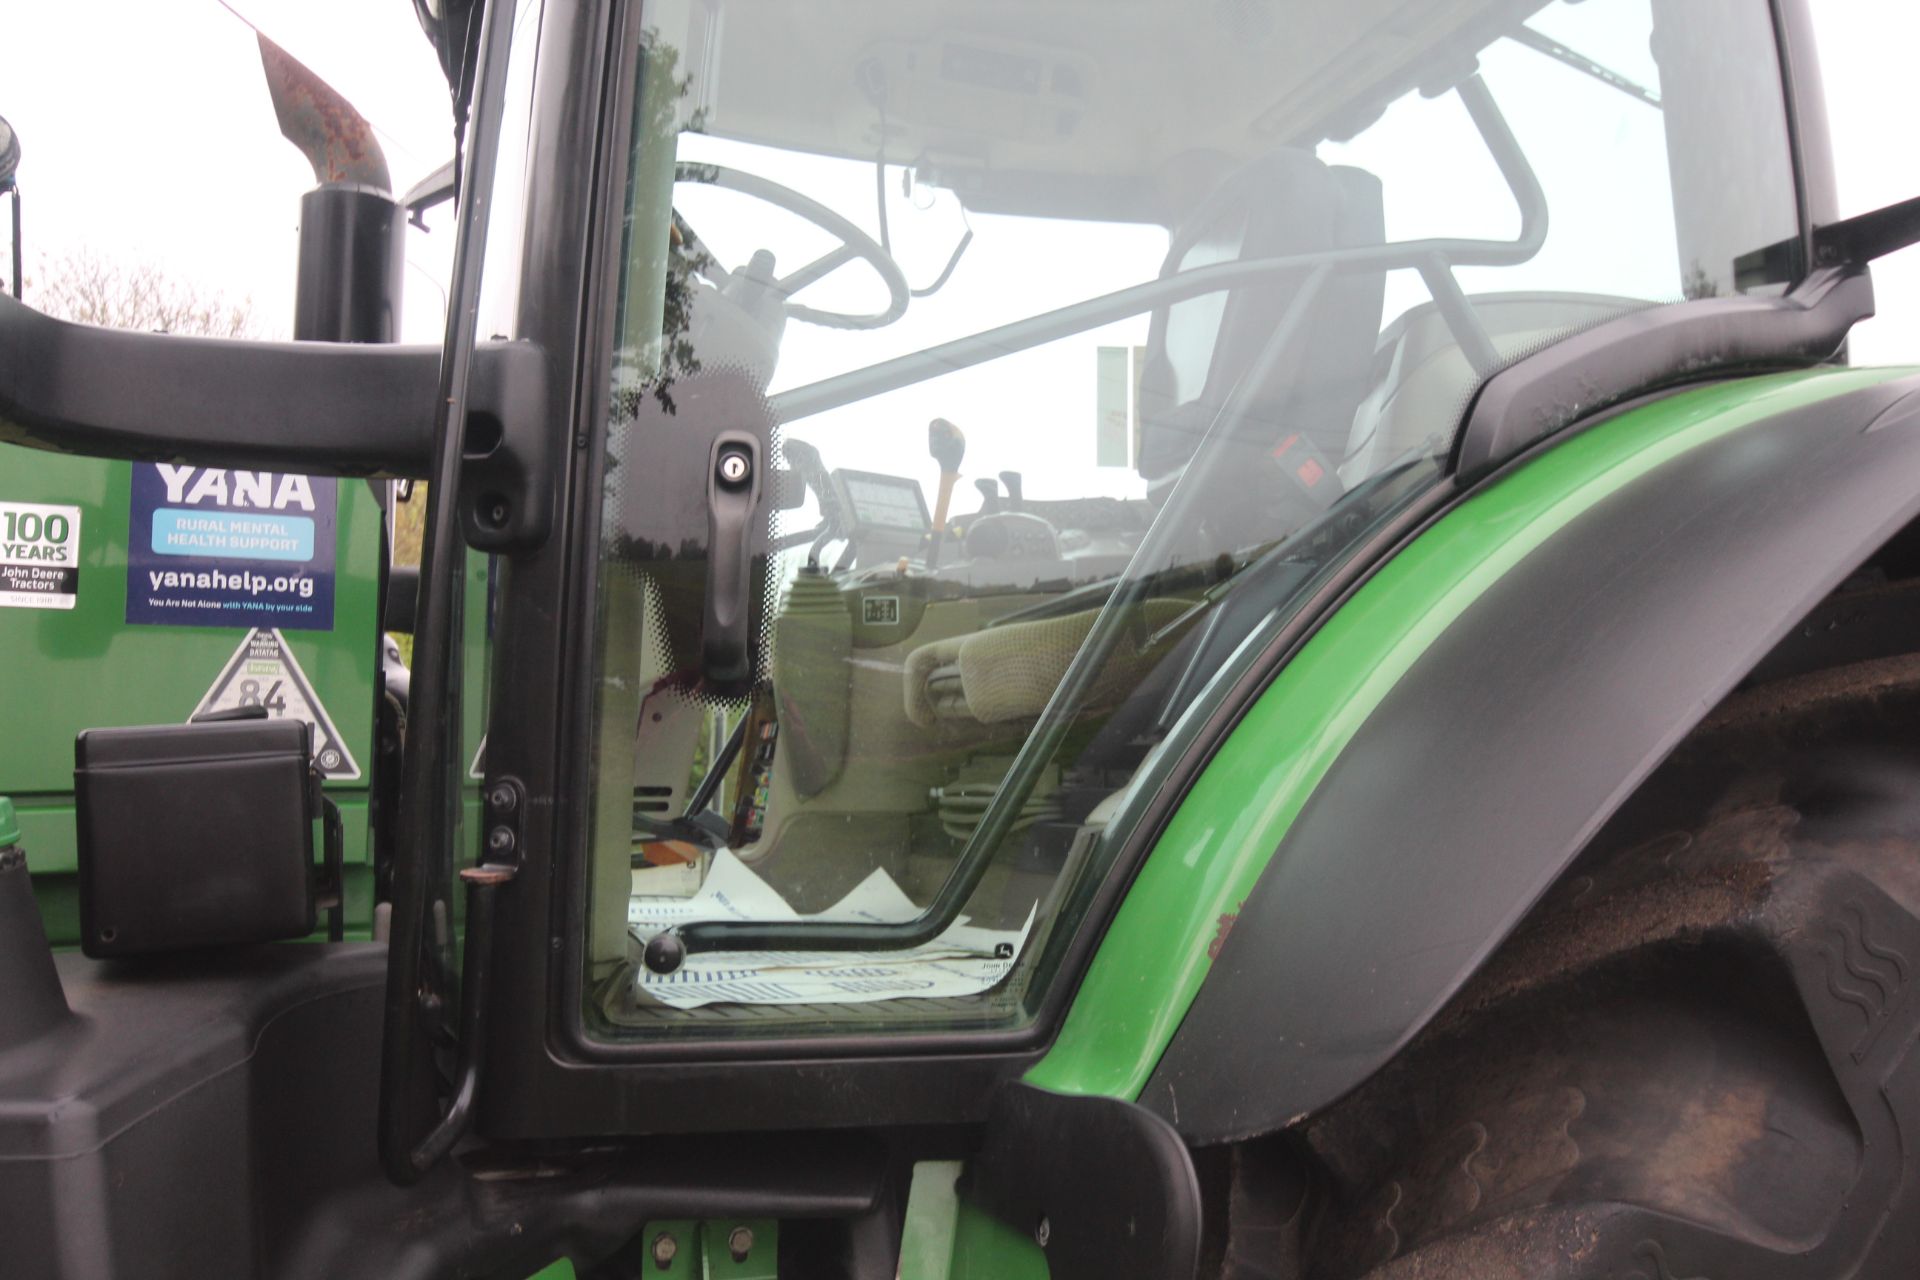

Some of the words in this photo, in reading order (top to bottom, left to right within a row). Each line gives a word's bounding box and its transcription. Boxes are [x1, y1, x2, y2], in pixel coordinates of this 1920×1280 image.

[155, 462, 315, 511] YANA
[3, 511, 69, 544] 100
[176, 517, 226, 532] RURAL
[230, 521, 288, 536] MENTAL
[167, 533, 226, 547] HEALTH
[230, 537, 299, 551] SUPPORT
[2, 543, 68, 561] YEARS
[1, 566, 29, 578] John
[32, 567, 64, 580] Deere
[10, 577, 55, 590] Tractors
[149, 569, 314, 598] yanahelp.org
[148, 598, 164, 607] You
[165, 598, 180, 607] Are
[181, 599, 196, 608] Not
[197, 599, 221, 609] Alone
[222, 601, 240, 610] with
[242, 601, 264, 611] YANA
[265, 602, 275, 612] by
[276, 603, 294, 613] your
[295, 603, 313, 613] side
[249, 648, 279, 657] DATATAG
[250, 640, 279, 648] WARNING
